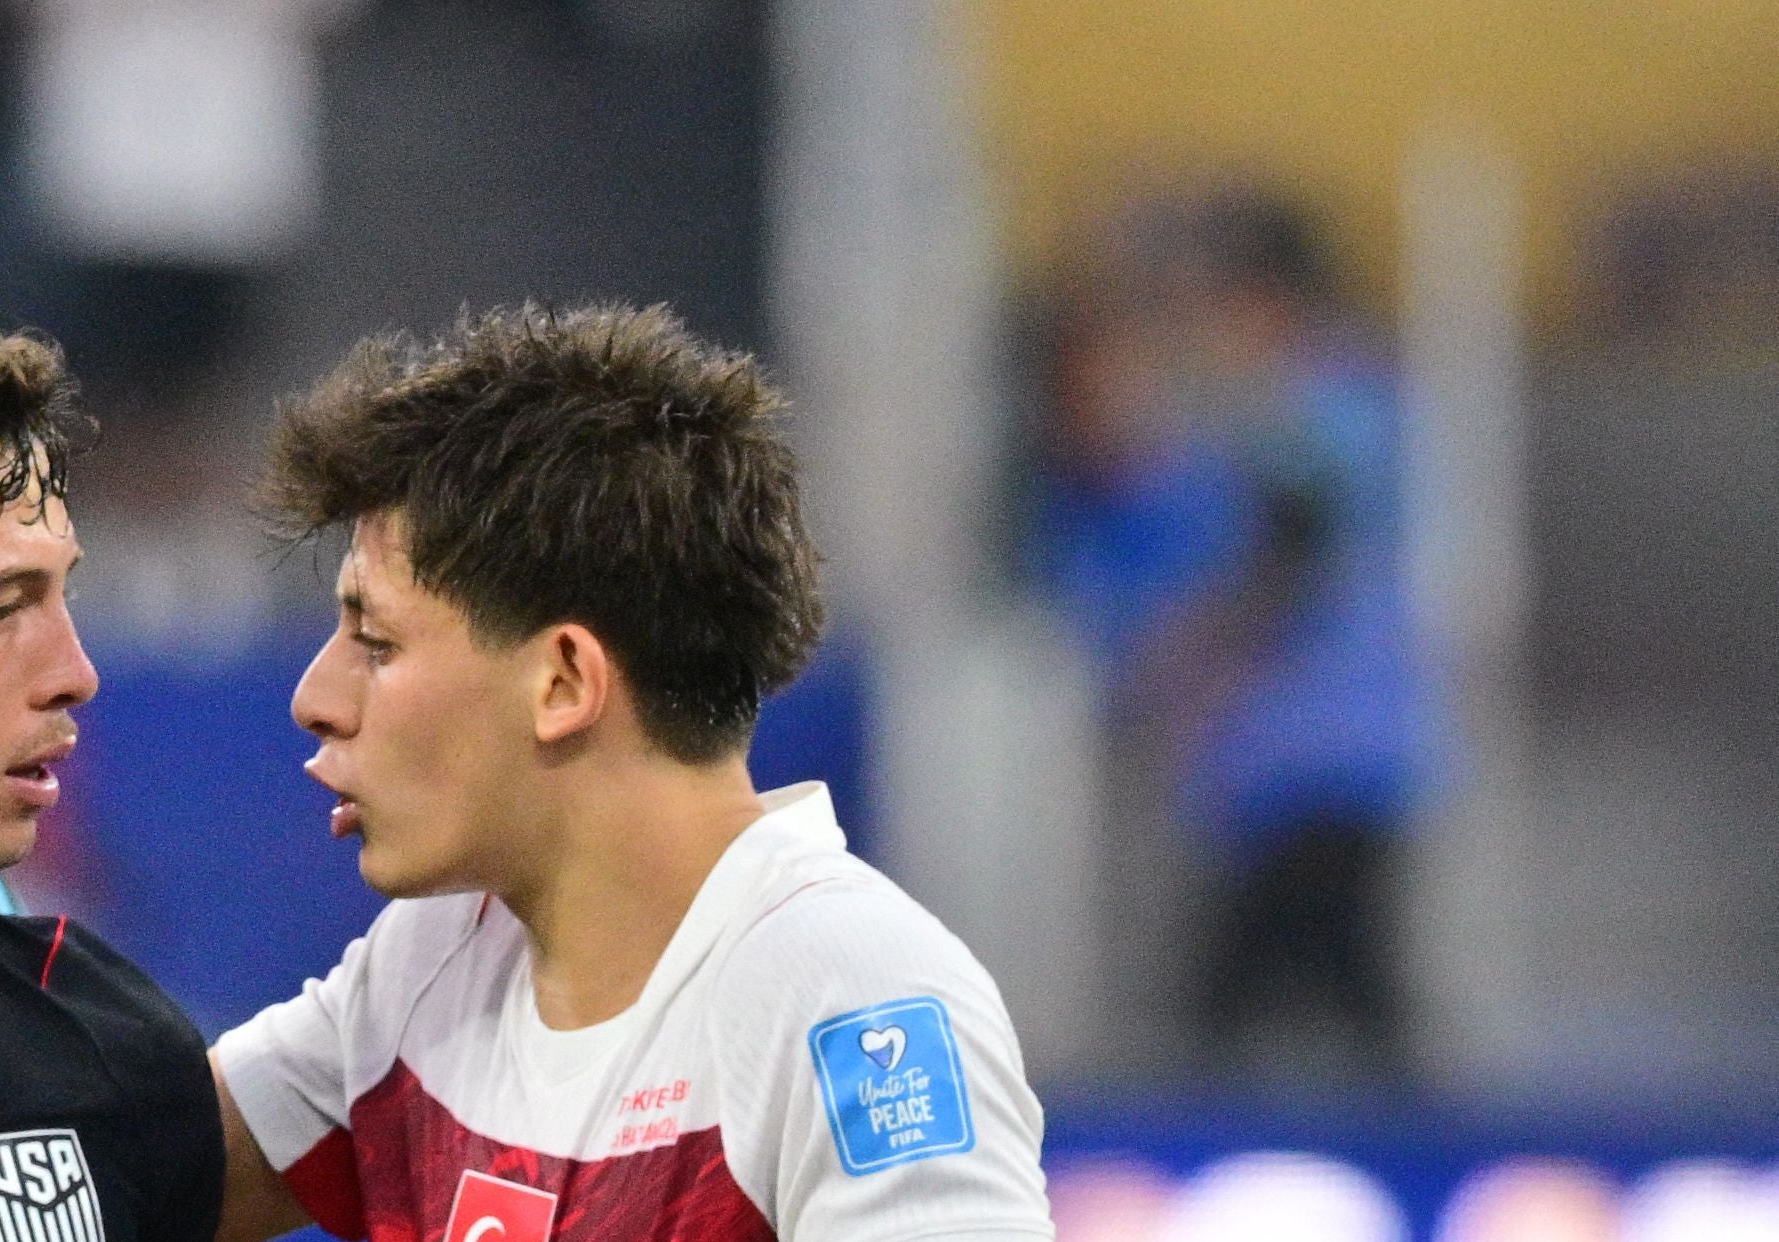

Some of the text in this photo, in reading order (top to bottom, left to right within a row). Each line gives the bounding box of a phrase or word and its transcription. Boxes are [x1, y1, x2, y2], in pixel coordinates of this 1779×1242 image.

[902, 1066, 931, 1096] For
[869, 1094, 935, 1134] PEACE
[889, 1127, 926, 1149] FIFA
